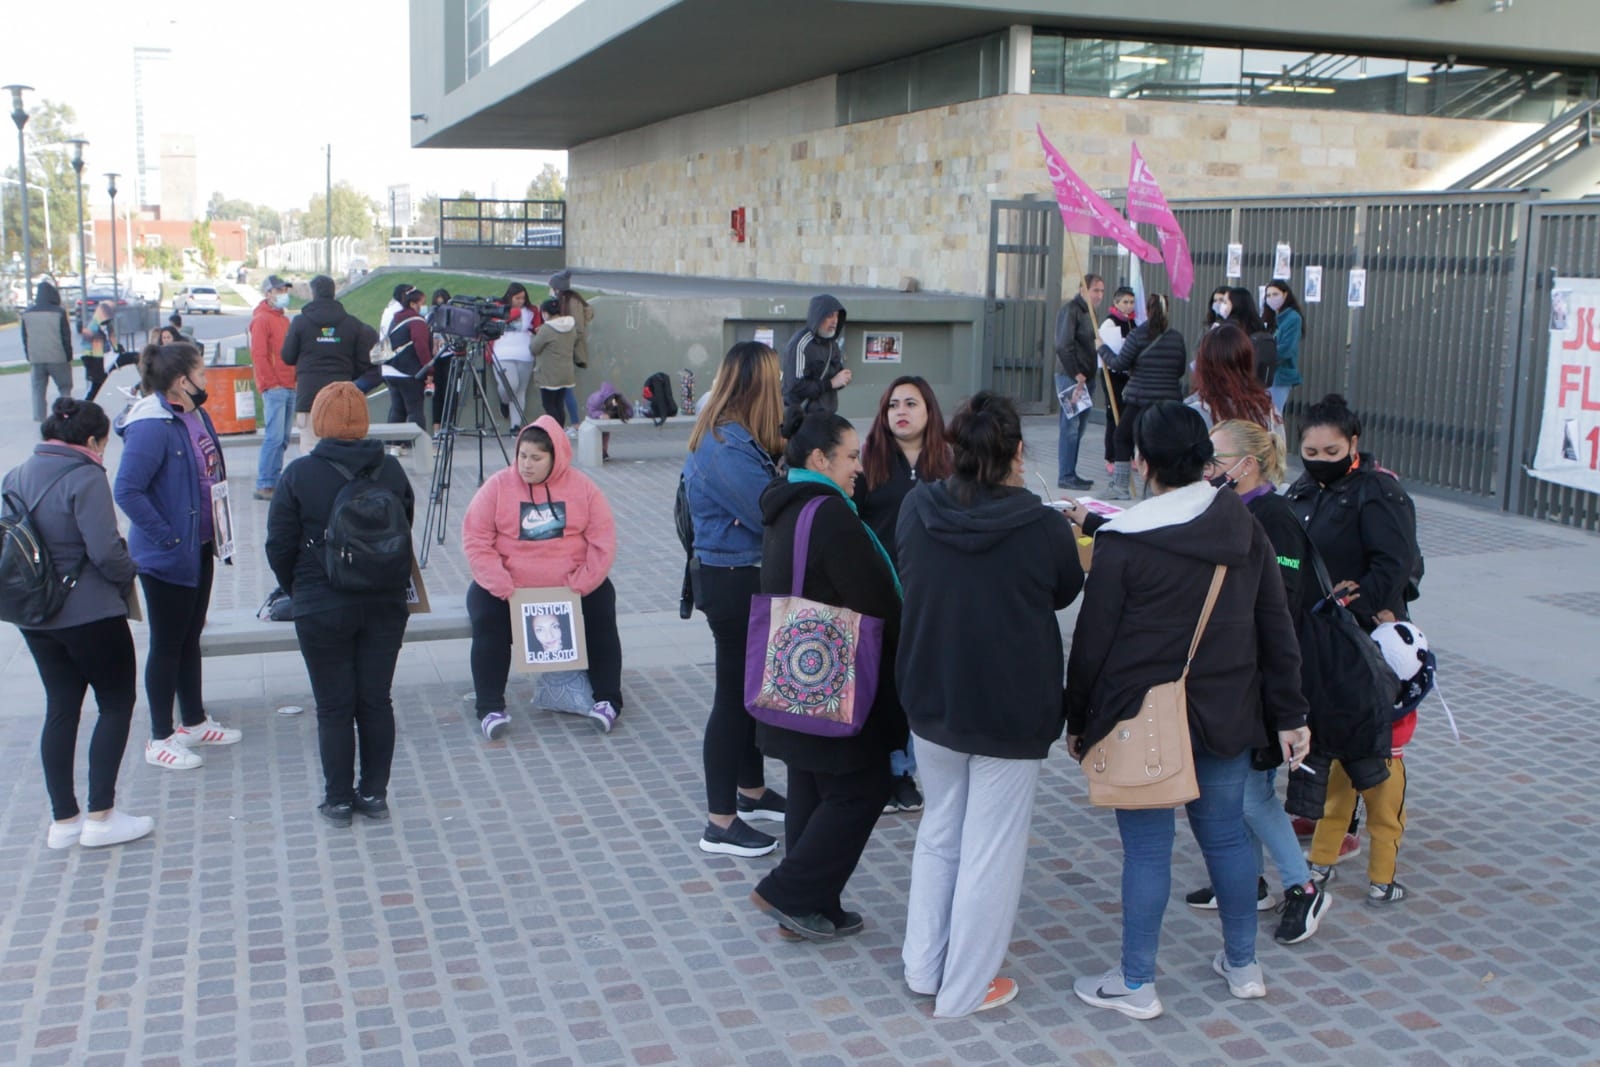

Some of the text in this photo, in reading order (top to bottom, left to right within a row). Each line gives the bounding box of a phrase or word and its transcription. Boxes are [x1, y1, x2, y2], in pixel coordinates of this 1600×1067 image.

[524, 604, 570, 616] JUSTICIA
[528, 649, 576, 661] FLOR SOTO
